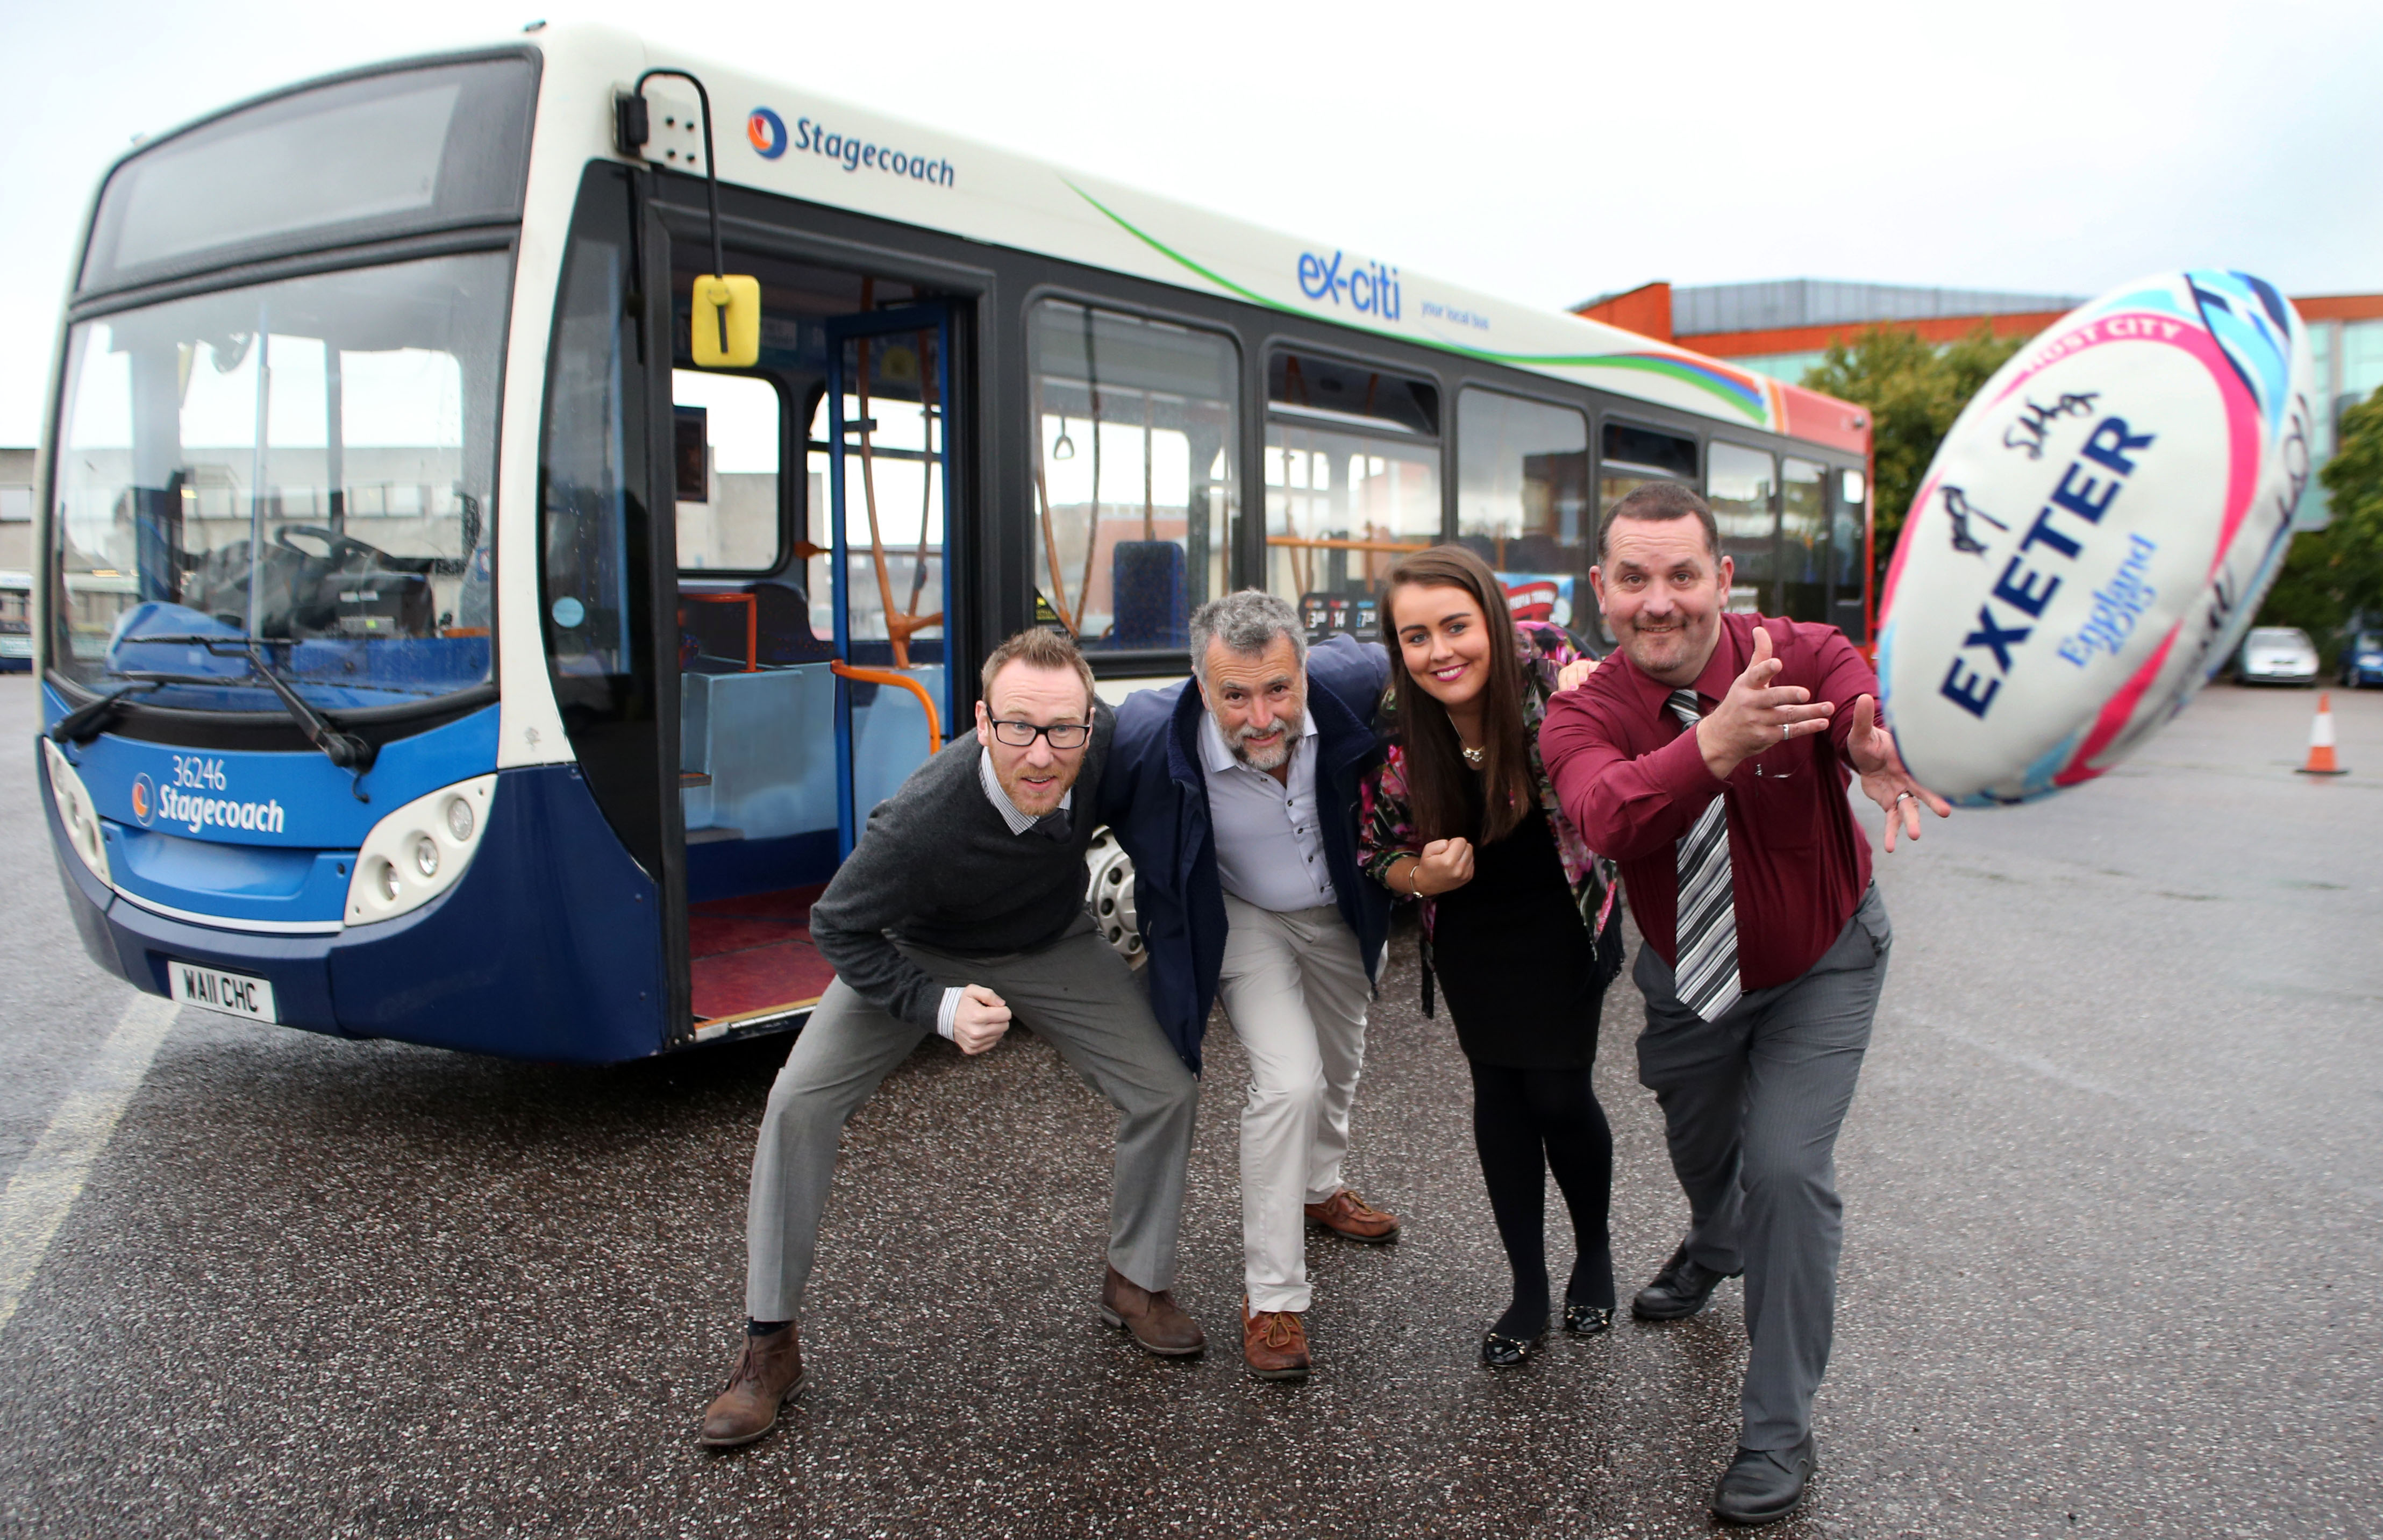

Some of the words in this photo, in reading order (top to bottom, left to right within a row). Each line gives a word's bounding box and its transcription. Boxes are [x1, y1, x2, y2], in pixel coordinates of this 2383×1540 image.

[795, 117, 955, 188] Stagecoach
[1297, 250, 1401, 322] ex-citi
[2106, 317, 2183, 340] CITY
[1938, 414, 2156, 721] EXETER
[173, 754, 227, 792] 36246
[158, 783, 284, 834] Stagecoach
[221, 976, 258, 1013] CHC
